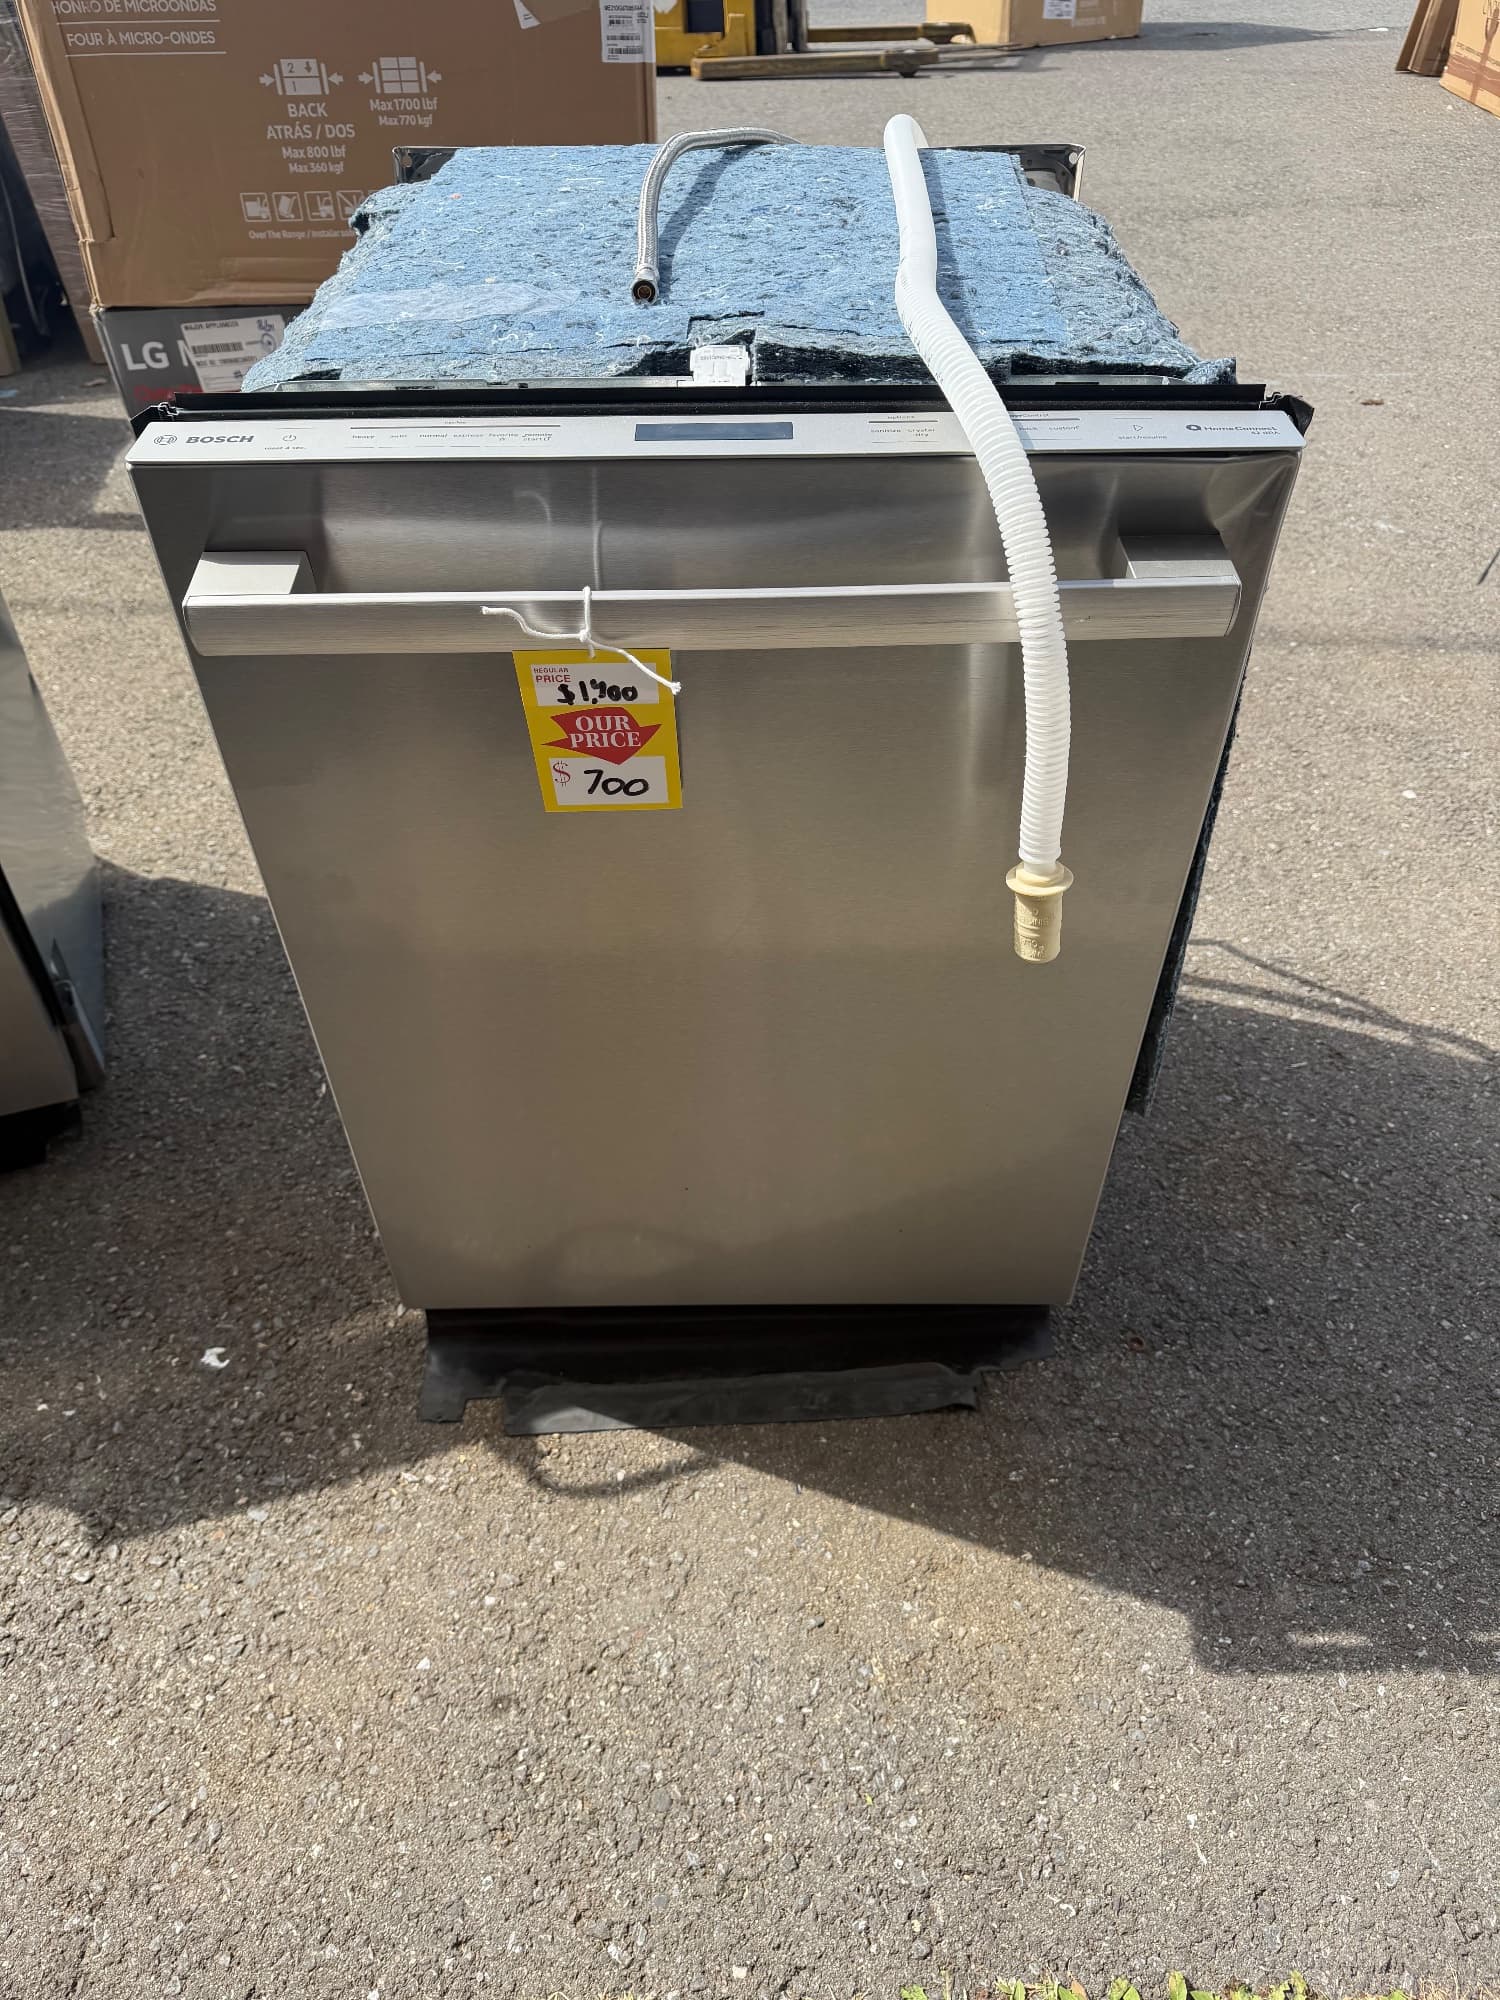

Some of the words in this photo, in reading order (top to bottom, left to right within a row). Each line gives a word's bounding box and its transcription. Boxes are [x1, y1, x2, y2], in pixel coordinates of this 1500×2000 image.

[104, 0, 123, 13] DE
[125, 0, 217, 13] MICROONDAS
[66, 33, 104, 47] FOUR
[106, 28, 117, 46] À
[118, 31, 216, 46] MICRO-ONDES
[287, 62, 295, 73] 2
[287, 103, 328, 118] BACK
[369, 99, 393, 112] Max
[393, 98, 420, 111] 1700
[422, 98, 438, 110] lbf
[379, 116, 399, 126] Max
[399, 115, 416, 125] 770
[266, 121, 312, 140] ATRÁS
[315, 124, 321, 140] /
[325, 123, 356, 138] DOS
[282, 147, 306, 159] Max
[307, 146, 329, 158] 800
[331, 145, 346, 158] lbf
[289, 163, 310, 174] Max
[309, 163, 327, 173] 360
[120, 341, 170, 371] LG
[185, 435, 254, 444] BOSCH
[535, 675, 571, 683] PRICE
[575, 715, 631, 731] OUR
[569, 732, 641, 748] PRICE
[552, 760, 571, 787] $
[583, 769, 649, 796] 700
